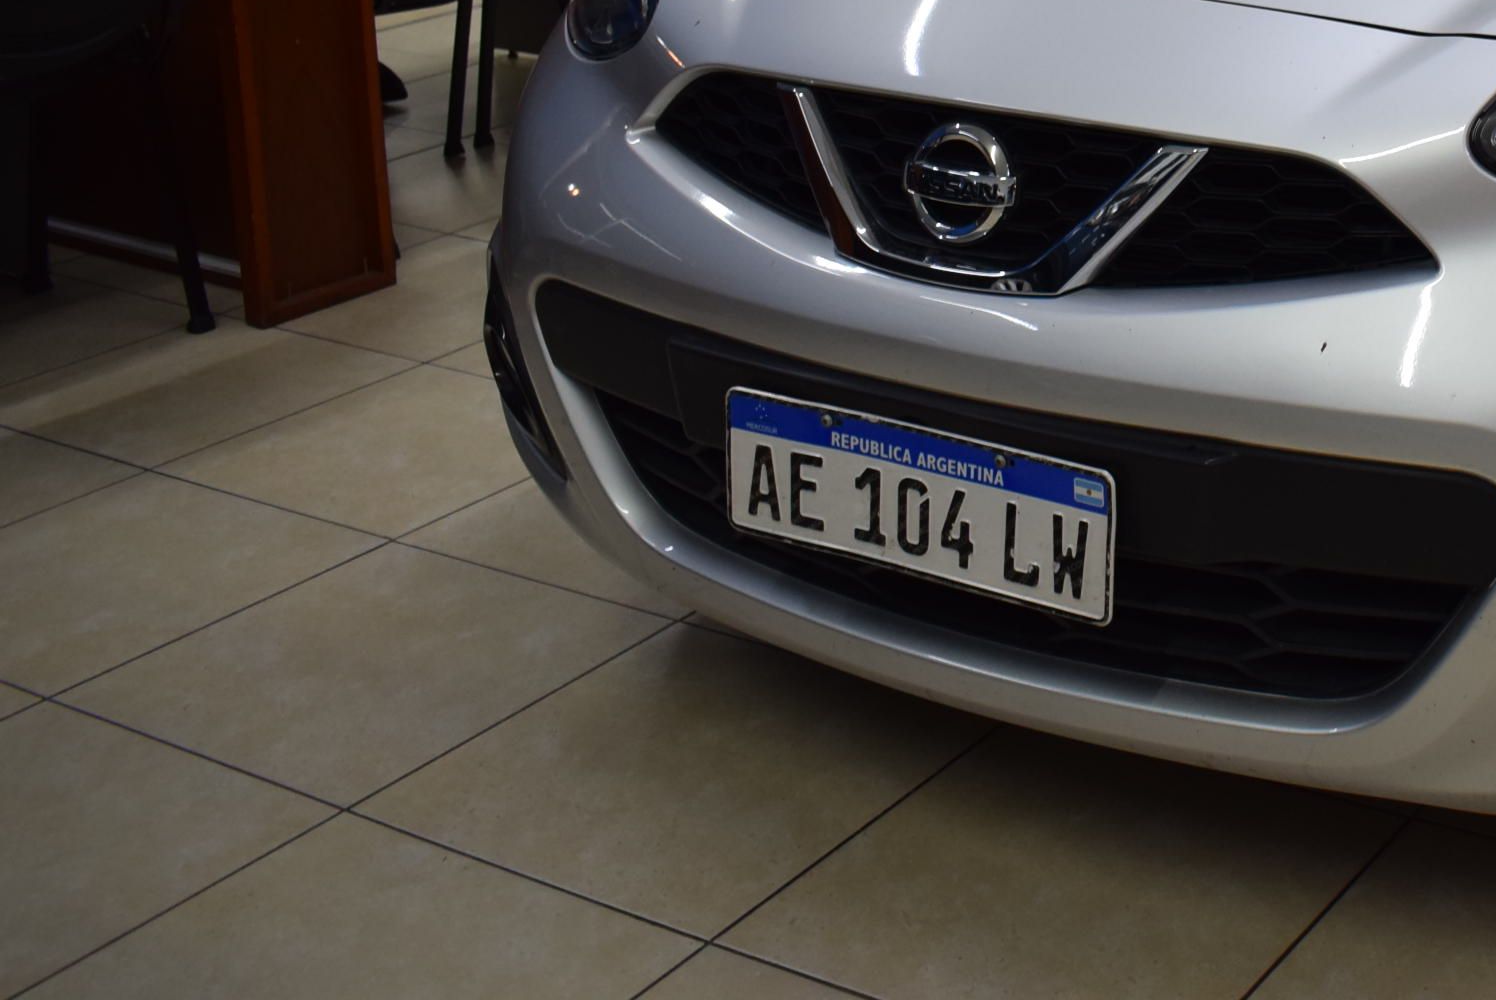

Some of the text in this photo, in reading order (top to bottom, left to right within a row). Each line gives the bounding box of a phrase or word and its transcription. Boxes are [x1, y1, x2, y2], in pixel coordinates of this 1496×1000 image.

[911, 168, 998, 204] ISSAN
[831, 431, 1004, 486] REPUBLICA ARGENTINA
[748, 444, 1089, 600] AE 104 LW
